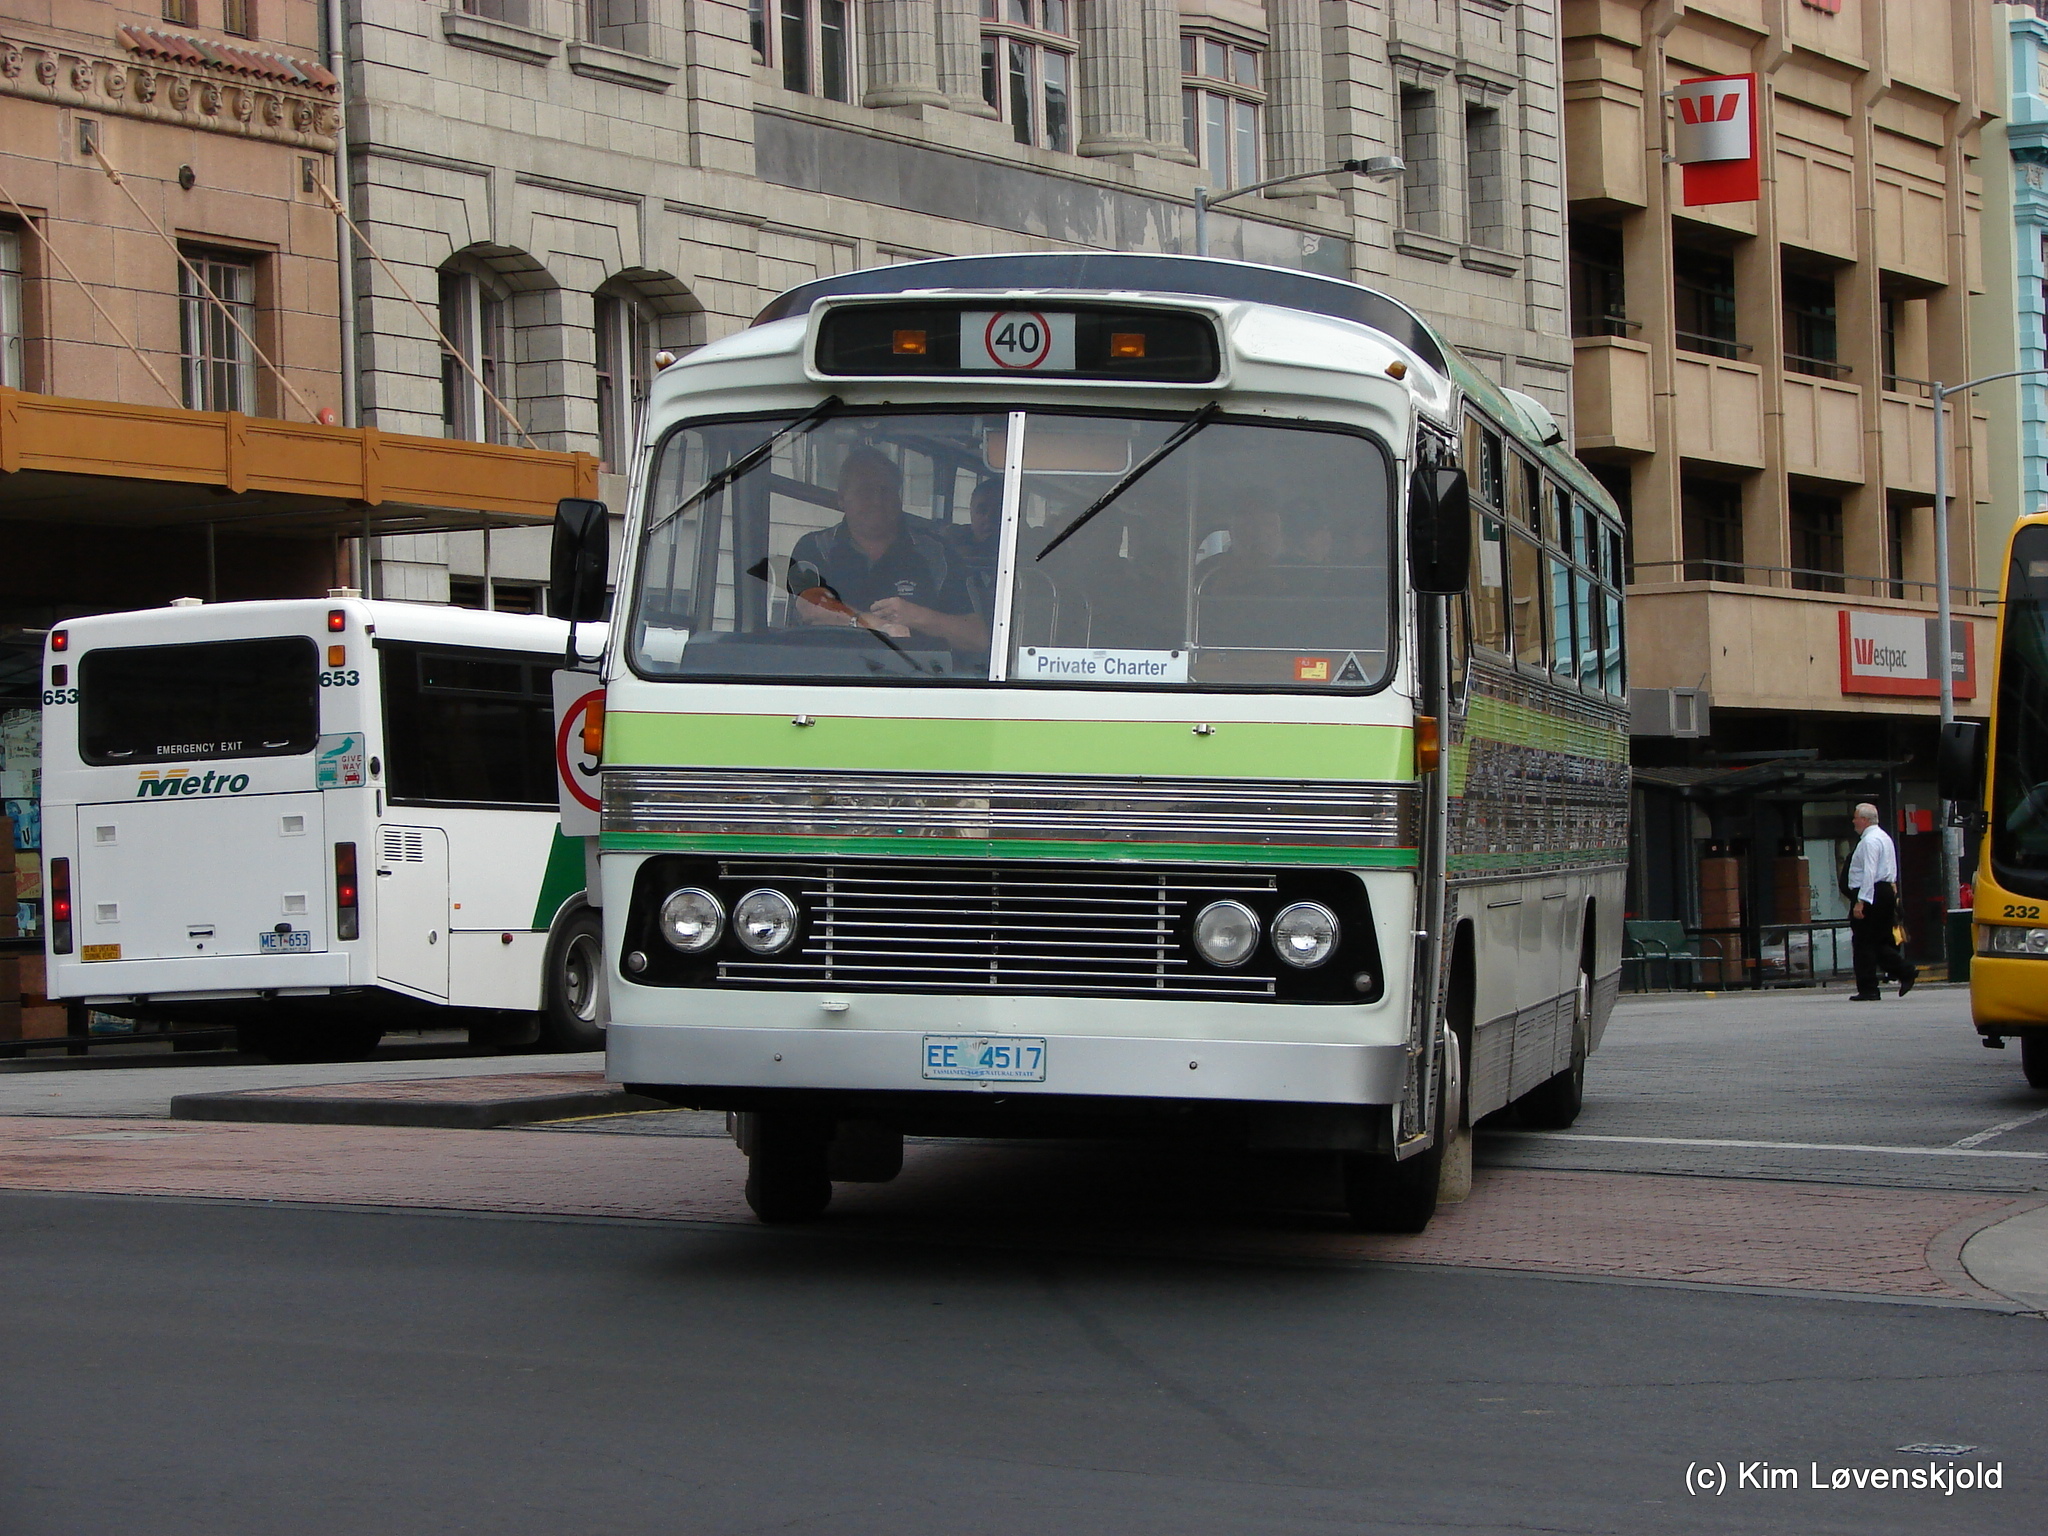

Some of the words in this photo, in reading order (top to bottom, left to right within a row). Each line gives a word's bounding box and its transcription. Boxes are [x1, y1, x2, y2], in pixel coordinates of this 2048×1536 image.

[995, 322, 1040, 353] 40
[1854, 638, 1907, 672] Westpac
[1037, 656, 1097, 675] Private
[1104, 657, 1168, 676] Charter
[319, 670, 360, 687] 653
[43, 688, 79, 706] 653
[156, 742, 215, 755] EMERGENCY
[221, 741, 243, 751] EXIT
[341, 755, 362, 763] GIVE
[342, 763, 361, 771] WAY
[137, 768, 250, 797] Metro
[2003, 904, 2041, 919] 232
[261, 934, 284, 948] MET
[288, 933, 309, 947] 653
[927, 1045, 958, 1067] EE
[979, 1046, 1042, 1069] 4517
